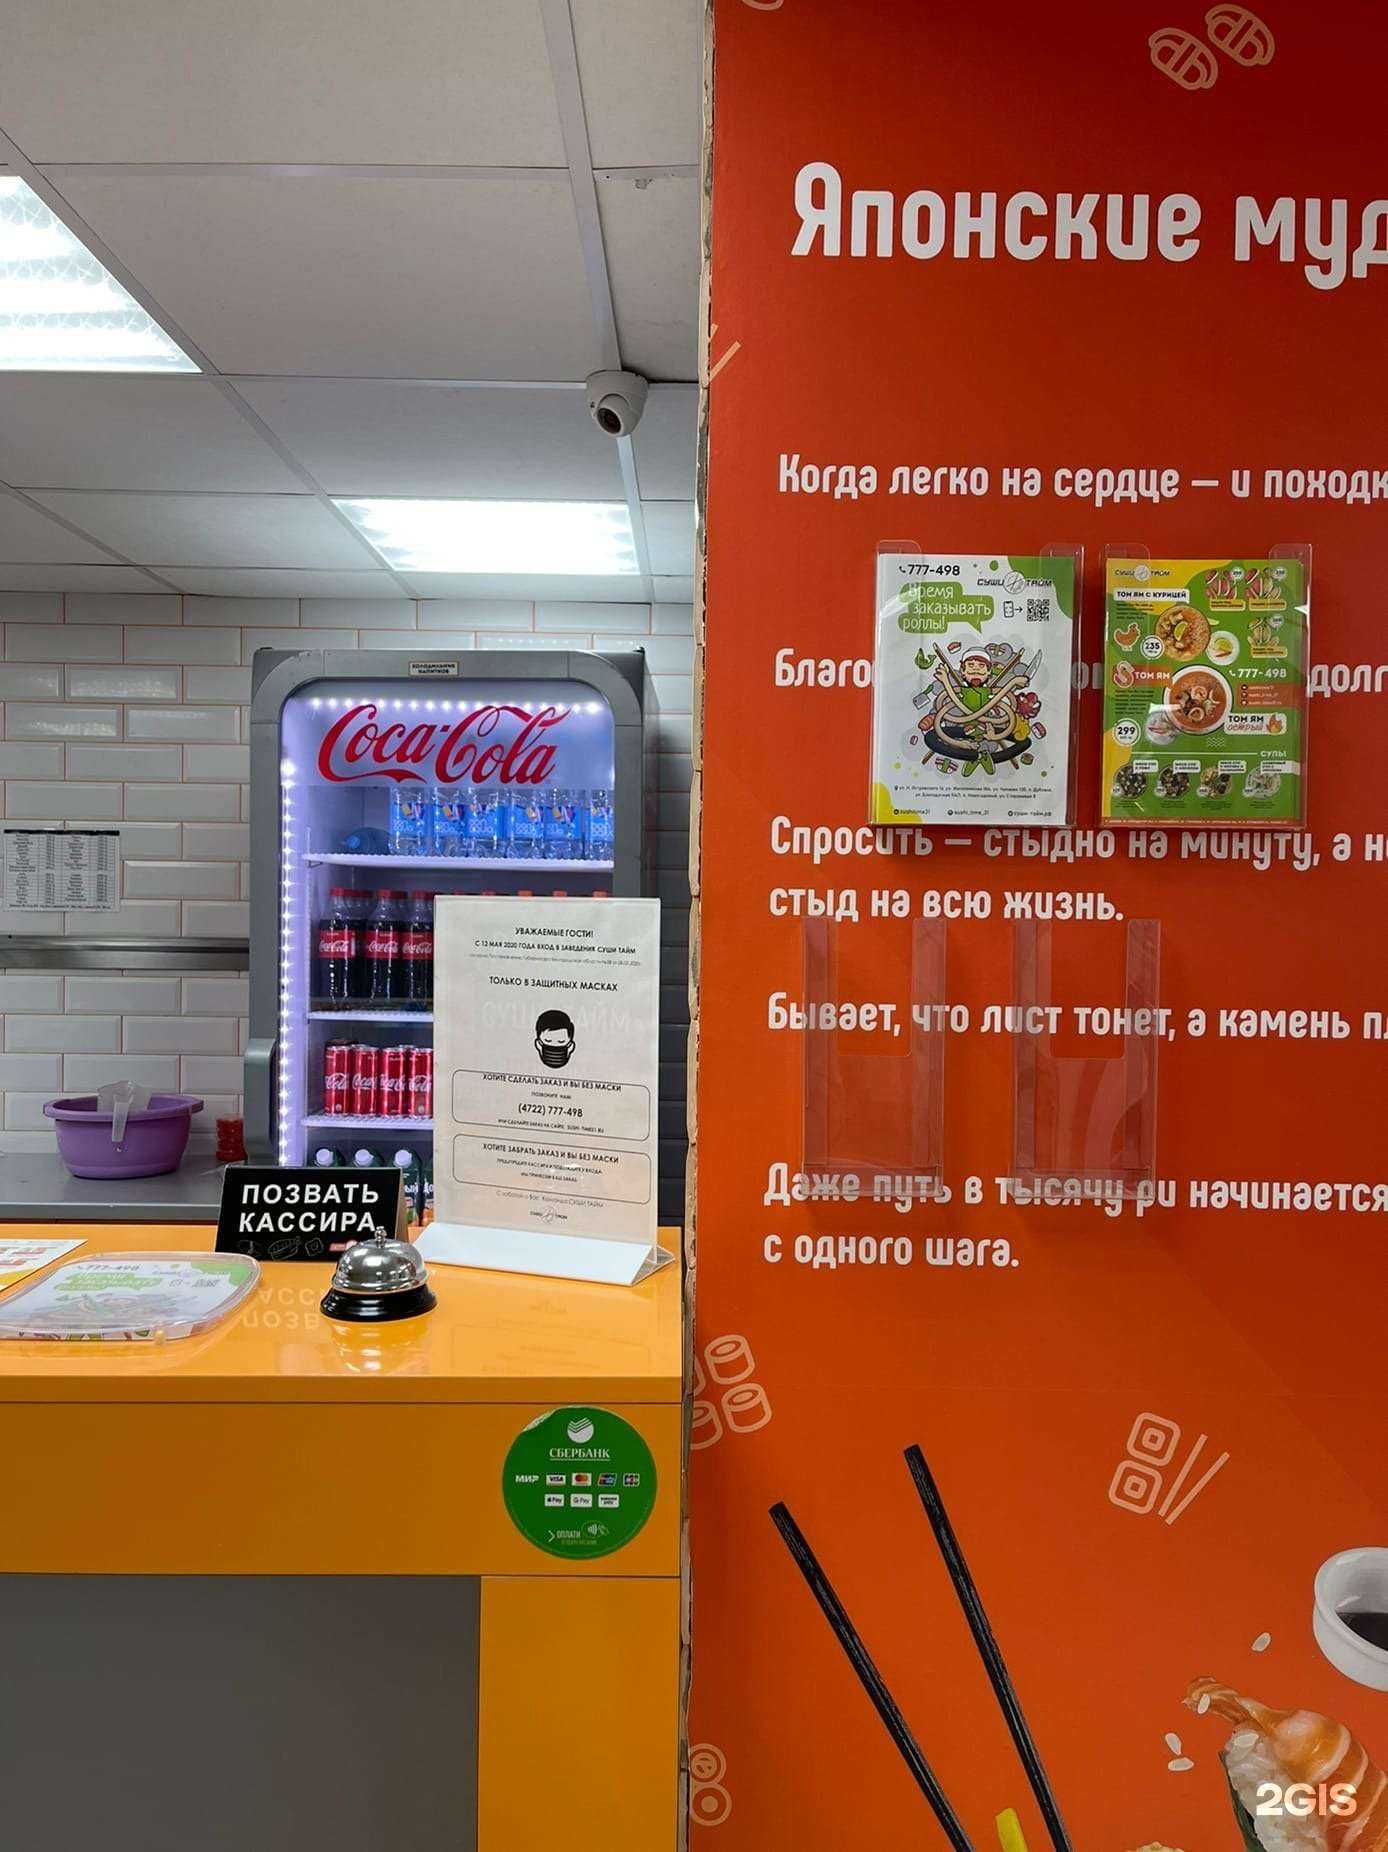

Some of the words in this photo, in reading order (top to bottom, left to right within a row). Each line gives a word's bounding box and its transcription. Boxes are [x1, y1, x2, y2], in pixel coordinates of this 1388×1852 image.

[791, 162, 1201, 261] Японские
[778, 454, 878, 499] Когда
[888, 466, 989, 496] легко
[1002, 467, 1042, 497] на
[1055, 468, 1180, 507] сердце
[1231, 469, 1251, 498] и
[907, 564, 960, 577] 777-498
[1153, 590, 1187, 599] КУРИЦЕЙ
[914, 602, 993, 617] заказывать
[901, 617, 946, 633] роллы!
[1145, 642, 1160, 650] 235
[1134, 671, 1153, 680] ТОМ
[1237, 668, 1288, 679] 777-498
[1228, 715, 1248, 723] ТОМ
[1250, 715, 1264, 723] ЯМ
[1117, 726, 1136, 735] 299
[317, 703, 572, 785] Coca-Cola
[771, 816, 933, 864] Спросить
[983, 829, 1115, 863] стыдно
[1128, 830, 1168, 859] на
[1181, 830, 1320, 871] минуту,
[1333, 832, 1352, 861] а
[769, 887, 859, 922] стыд
[871, 889, 910, 918] на
[923, 890, 992, 918] всю
[1003, 891, 1124, 921] жизнь.
[515, 927, 564, 937] УВАЖАЕМЫЕ
[565, 928, 594, 938] ГОСТИ!
[504, 941, 517, 949] 2020
[519, 942, 536, 950] ГОДА
[537, 943, 554, 951] ВХОД
[488, 976, 522, 986] ТОЛЬКО
[524, 978, 530, 986] В
[531, 978, 578, 990] ЗАЩИТНЫХ
[580, 981, 618, 991] МАСКАХ
[768, 992, 901, 1036] Бывает,
[912, 1004, 969, 1032] что
[980, 1005, 1062, 1034] лист
[1073, 1007, 1175, 1041] тонет,
[1187, 1008, 1206, 1036] а
[1219, 1009, 1350, 1039] камень
[482, 1073, 506, 1082] ХОТИТЕ
[507, 1075, 539, 1085] СДЕЛАТЬ
[540, 1077, 562, 1087] ЗАКАЗ
[563, 1080, 569, 1088] И
[570, 1081, 580, 1089] ВЫ
[581, 1082, 594, 1090] БЕЗ
[595, 1083, 622, 1092] МАСКИ
[518, 1102, 546, 1116] (4722)
[547, 1105, 583, 1118] 777-498
[482, 1143, 506, 1153] ХОТИТЕ
[507, 1145, 536, 1155] ЗАБРАТЬ
[537, 1148, 560, 1158] ЗАКАЗ
[567, 1151, 578, 1159] ВЫ
[579, 1152, 591, 1160] БЕЗ
[592, 1154, 619, 1163] МАСКИ
[241, 1183, 379, 1204] ПОЗВАТЬ
[764, 1162, 861, 1206] Даже
[873, 1175, 952, 1213] путь
[965, 1175, 983, 1204] в
[995, 1177, 1123, 1217] тысячу
[1136, 1180, 1176, 1217] ри
[1189, 1180, 1388, 1212] начинается
[238, 1211, 376, 1233] КАССИРА
[764, 1234, 782, 1263] с
[794, 1235, 913, 1269] одного
[926, 1237, 1020, 1268] шага.
[549, 1447, 611, 1459] СБЕРБАНК
[515, 1474, 540, 1483] МИР
